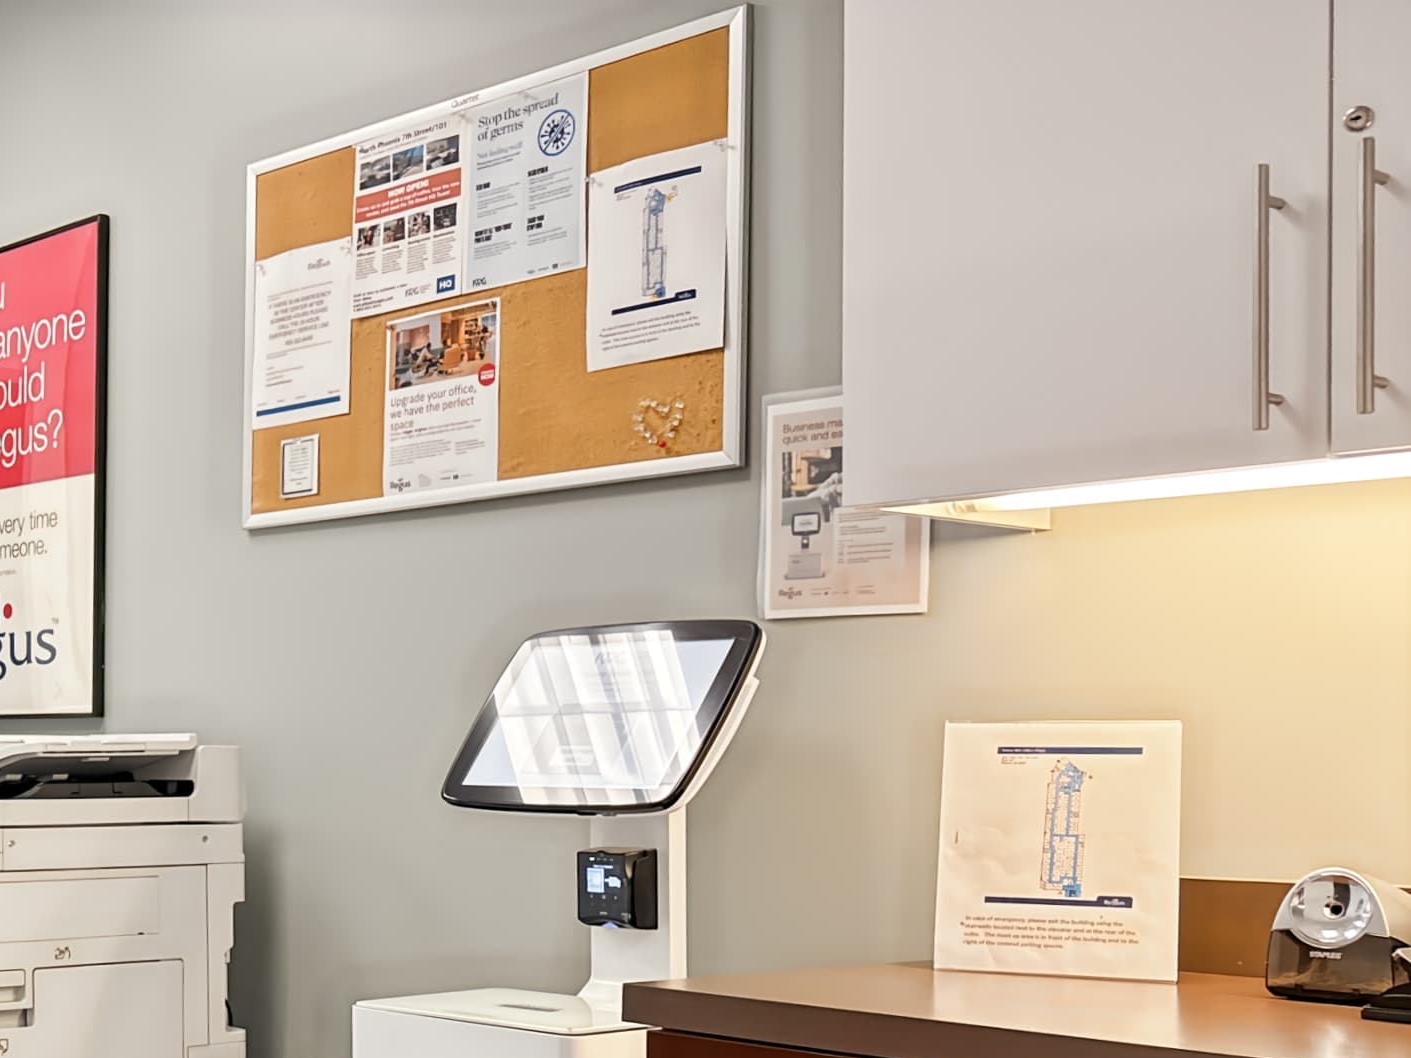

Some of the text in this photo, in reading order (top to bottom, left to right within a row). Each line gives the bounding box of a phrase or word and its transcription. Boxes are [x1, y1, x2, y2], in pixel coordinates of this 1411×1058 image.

[478, 92, 559, 127] Stop the spread
[489, 121, 524, 141] germs
[427, 389, 447, 403] your
[448, 383, 477, 397] office,
[390, 396, 475, 419] we have the perfect
[390, 419, 414, 433] space
[783, 421, 825, 434] Business
[783, 432, 808, 446] quick
[811, 429, 830, 441] and
[29, 509, 58, 530] time
